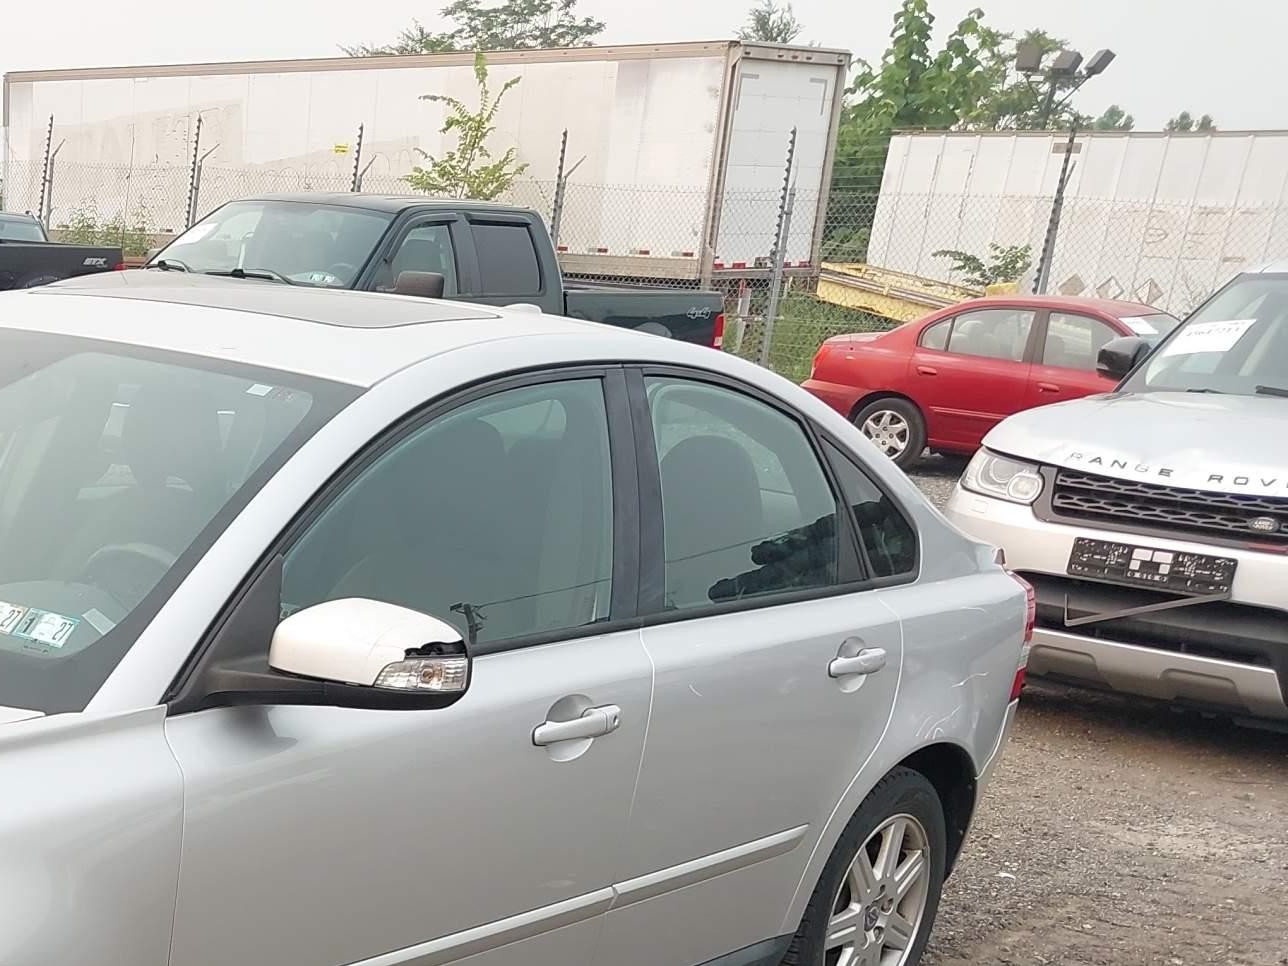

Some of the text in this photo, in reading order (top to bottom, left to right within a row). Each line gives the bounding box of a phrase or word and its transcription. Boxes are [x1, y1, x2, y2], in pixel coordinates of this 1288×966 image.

[1066, 452, 1288, 488] RANGE ROV
[0, 609, 22, 629] 27
[52, 622, 73, 641] 27
